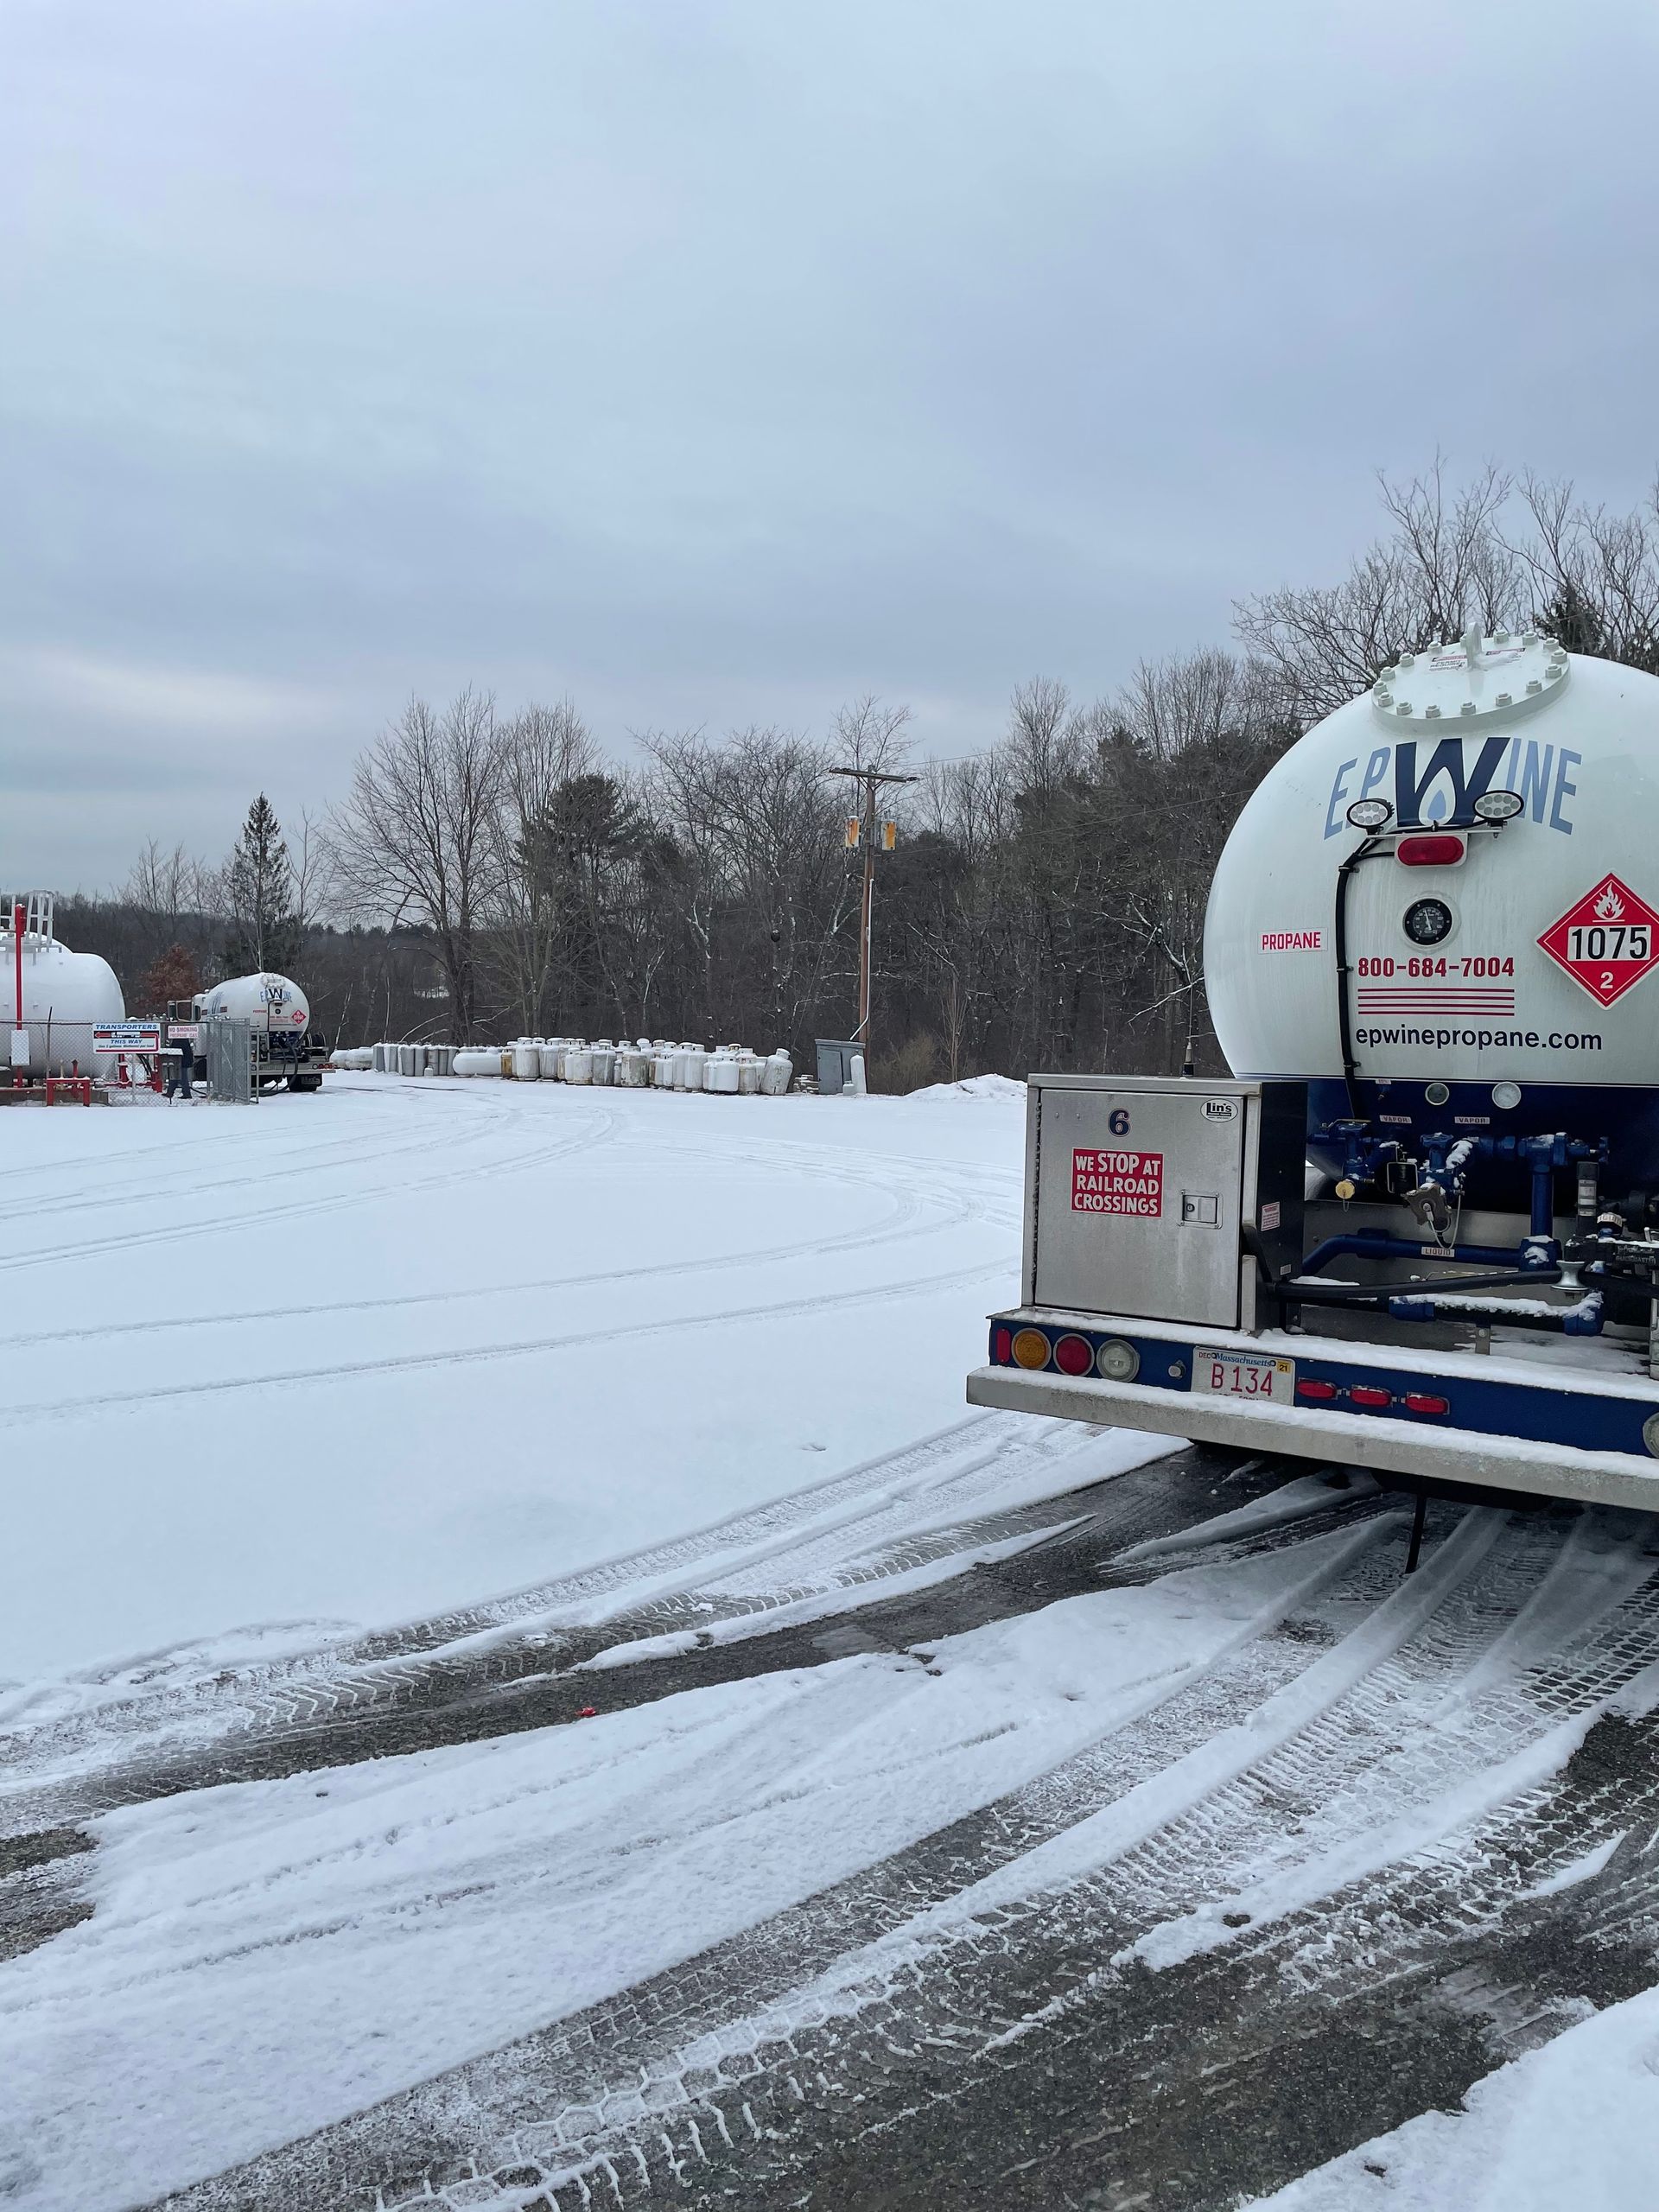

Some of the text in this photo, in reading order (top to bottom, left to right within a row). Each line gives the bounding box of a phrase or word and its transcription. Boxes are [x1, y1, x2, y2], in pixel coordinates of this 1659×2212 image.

[1262, 931, 1321, 950] PROPANE
[1572, 927, 1647, 960] 1075
[1358, 957, 1515, 977] 800-684-7004
[1600, 972, 1614, 988] 2
[1356, 1023, 1603, 1051] epwinepropane.com
[1206, 1102, 1232, 1116] Lin's
[1108, 1108, 1130, 1138] 6
[1075, 1153, 1161, 1176] WE STOP AT
[1077, 1174, 1160, 1195] RAILROAD
[1074, 1192, 1158, 1215] CROSSINGS
[1216, 1352, 1273, 1368] Massachusetts
[1211, 1363, 1273, 1396] B 134
